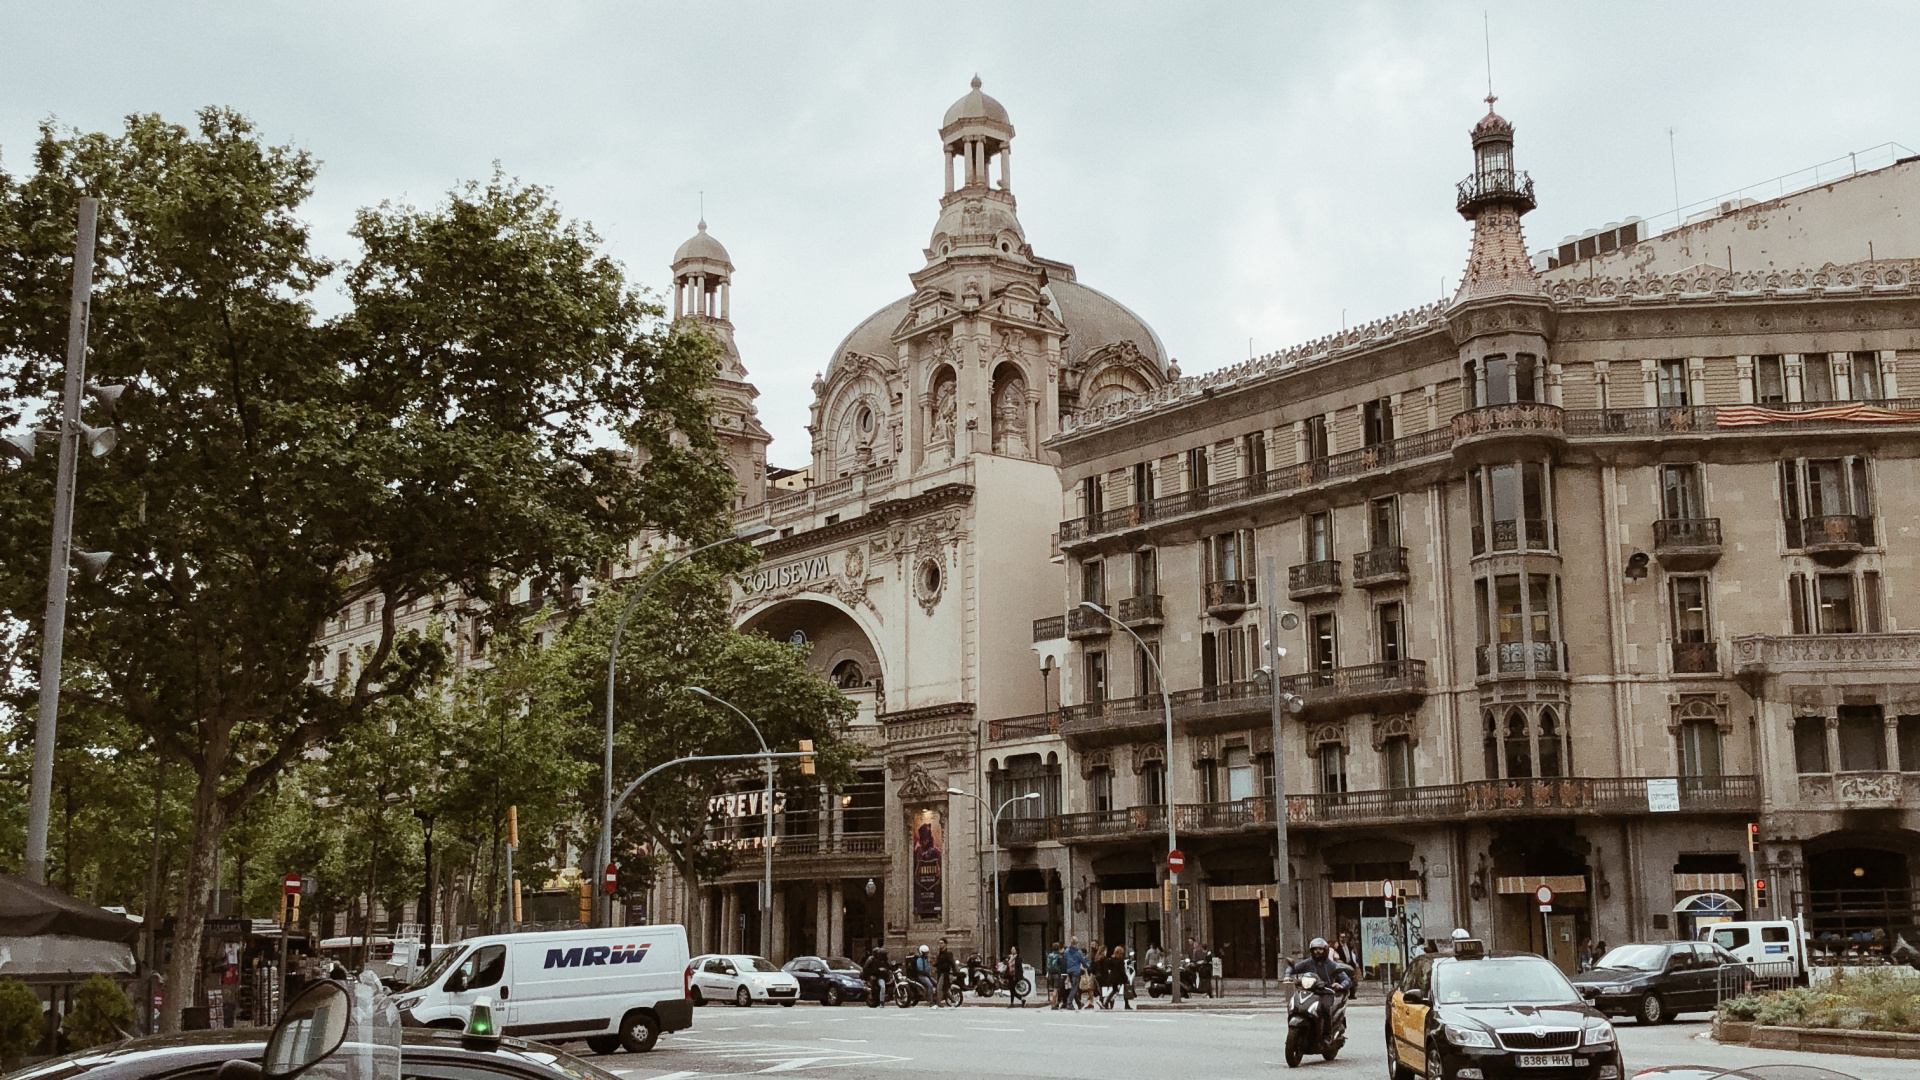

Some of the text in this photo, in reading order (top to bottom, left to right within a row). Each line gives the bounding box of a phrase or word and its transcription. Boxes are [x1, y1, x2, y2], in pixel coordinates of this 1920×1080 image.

[754, 836, 778, 849] POP
[543, 943, 652, 969] MRW
[1523, 1055, 1570, 1065] 8386 HHX
